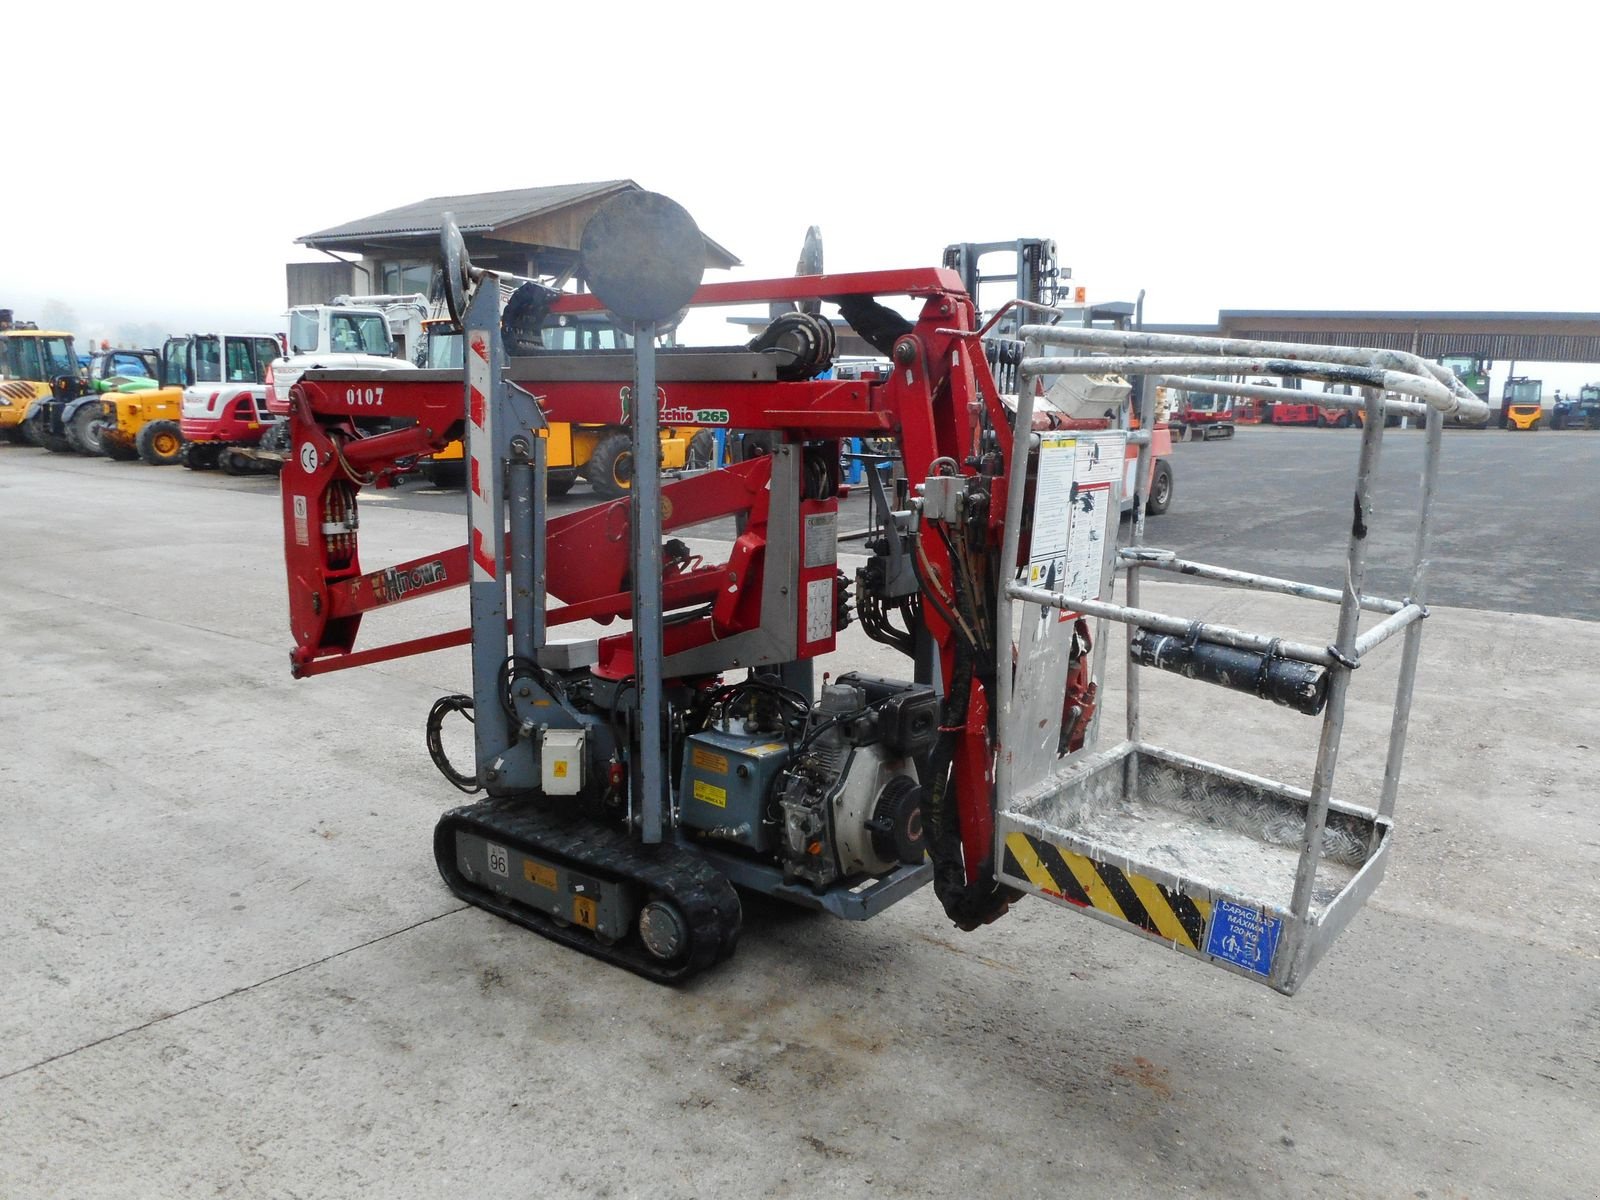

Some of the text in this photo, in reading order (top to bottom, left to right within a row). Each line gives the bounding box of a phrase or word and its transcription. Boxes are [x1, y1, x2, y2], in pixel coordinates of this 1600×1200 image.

[346, 388, 384, 405] 0107
[697, 411, 728, 422] 1265
[490, 854, 506, 873] 96
[1230, 925, 1244, 935] 120
